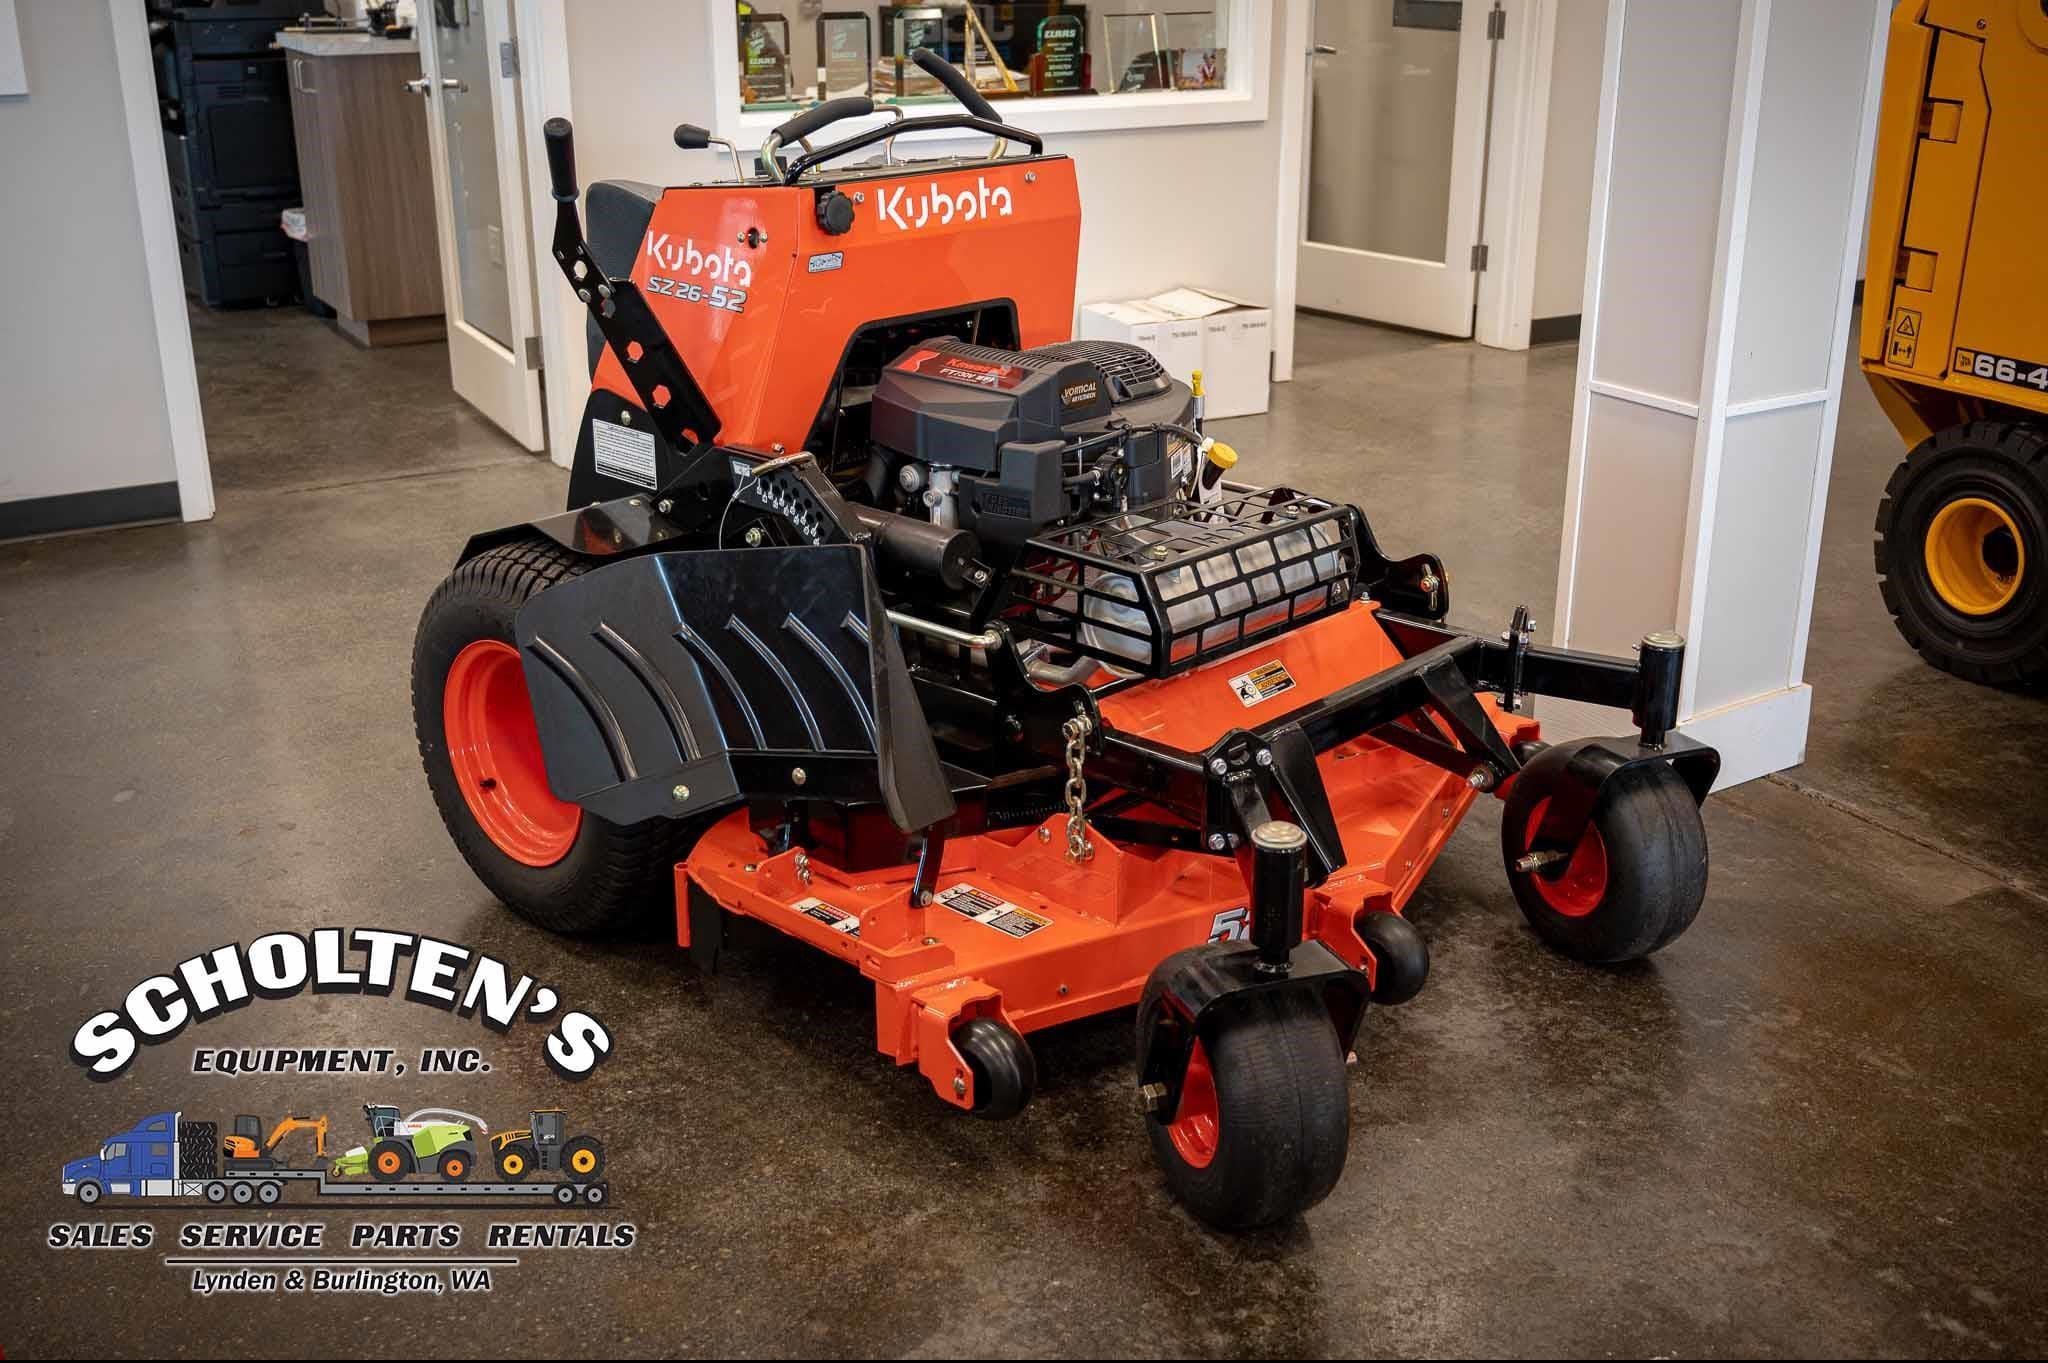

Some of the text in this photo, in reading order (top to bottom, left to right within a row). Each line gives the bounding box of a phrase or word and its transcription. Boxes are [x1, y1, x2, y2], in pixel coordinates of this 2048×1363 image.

[877, 176, 1013, 231] Kubota
[646, 229, 753, 288] Kubota
[646, 275, 748, 314] SZ26-52
[1207, 906, 1250, 943] 5
